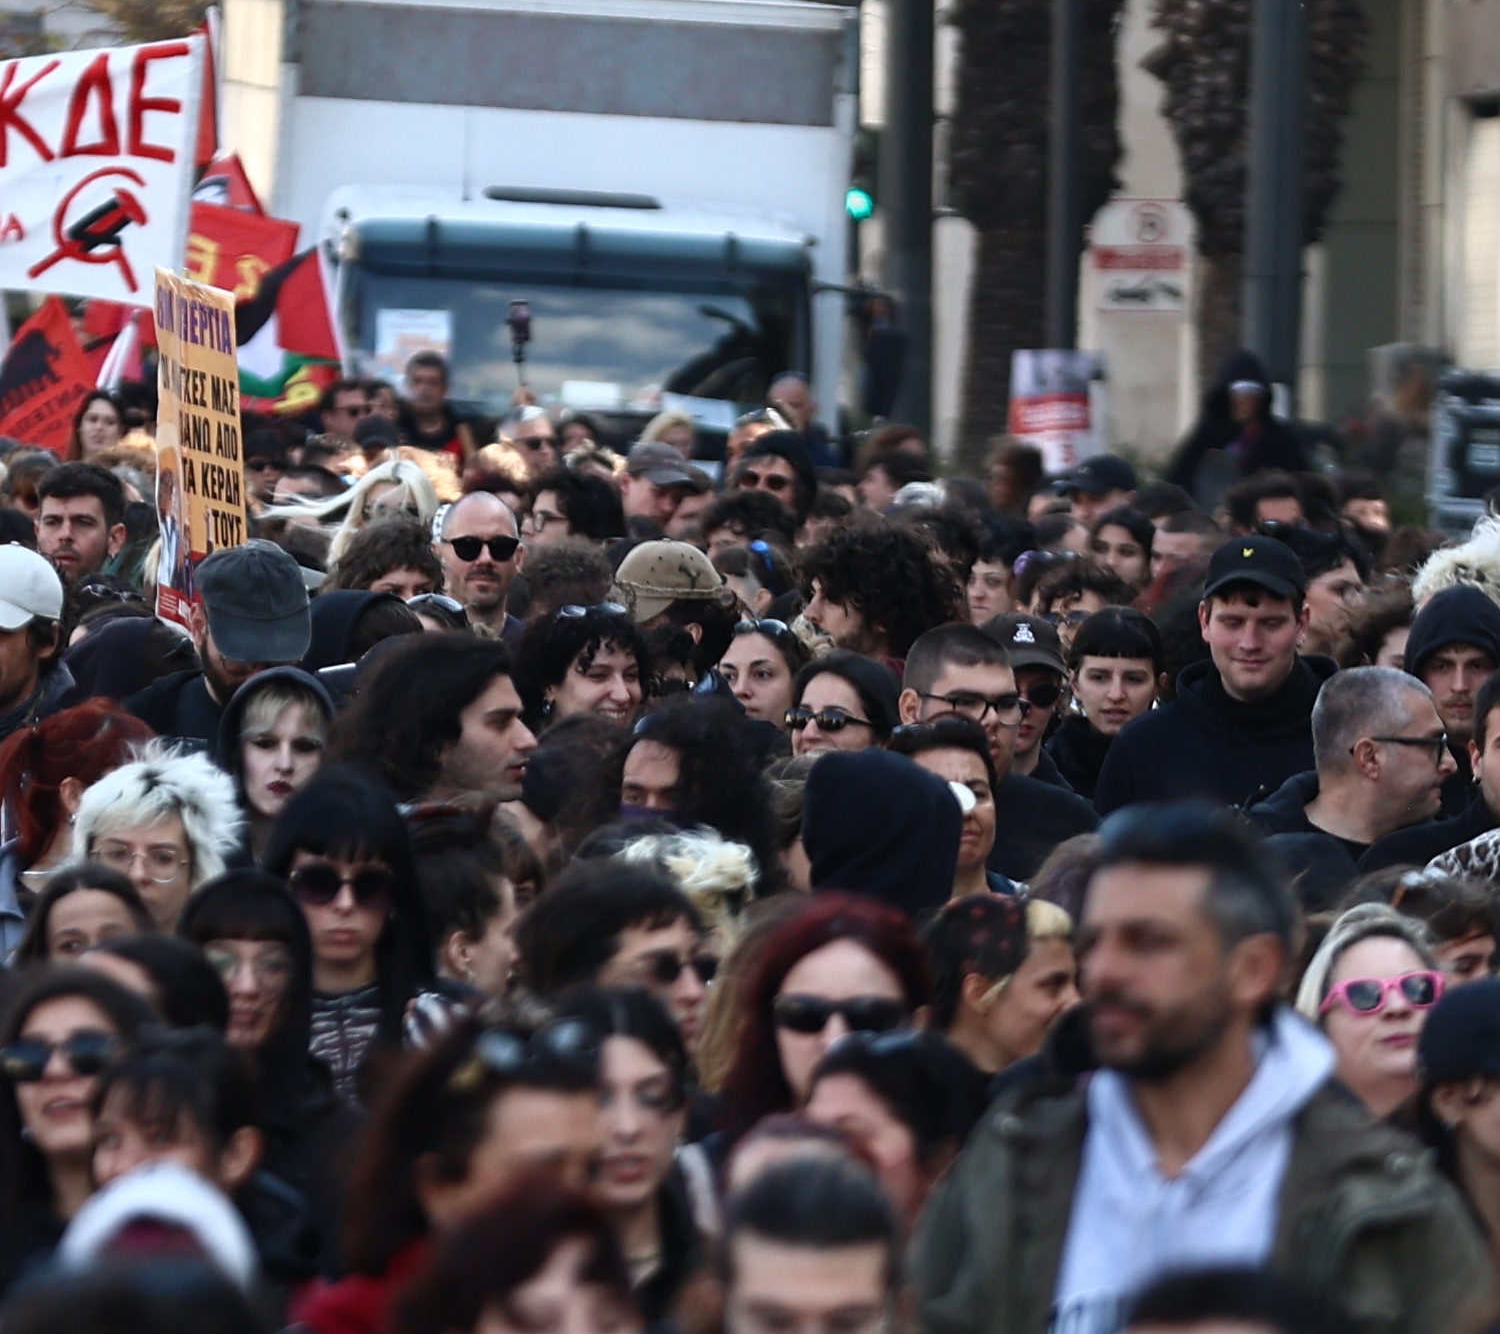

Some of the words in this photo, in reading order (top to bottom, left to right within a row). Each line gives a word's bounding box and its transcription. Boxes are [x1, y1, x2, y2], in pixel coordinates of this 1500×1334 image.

[211, 373, 237, 417] ΜΑΣ
[216, 421, 238, 462] ΑΠΟ
[201, 461, 241, 507] ΚΕΡΔΗ
